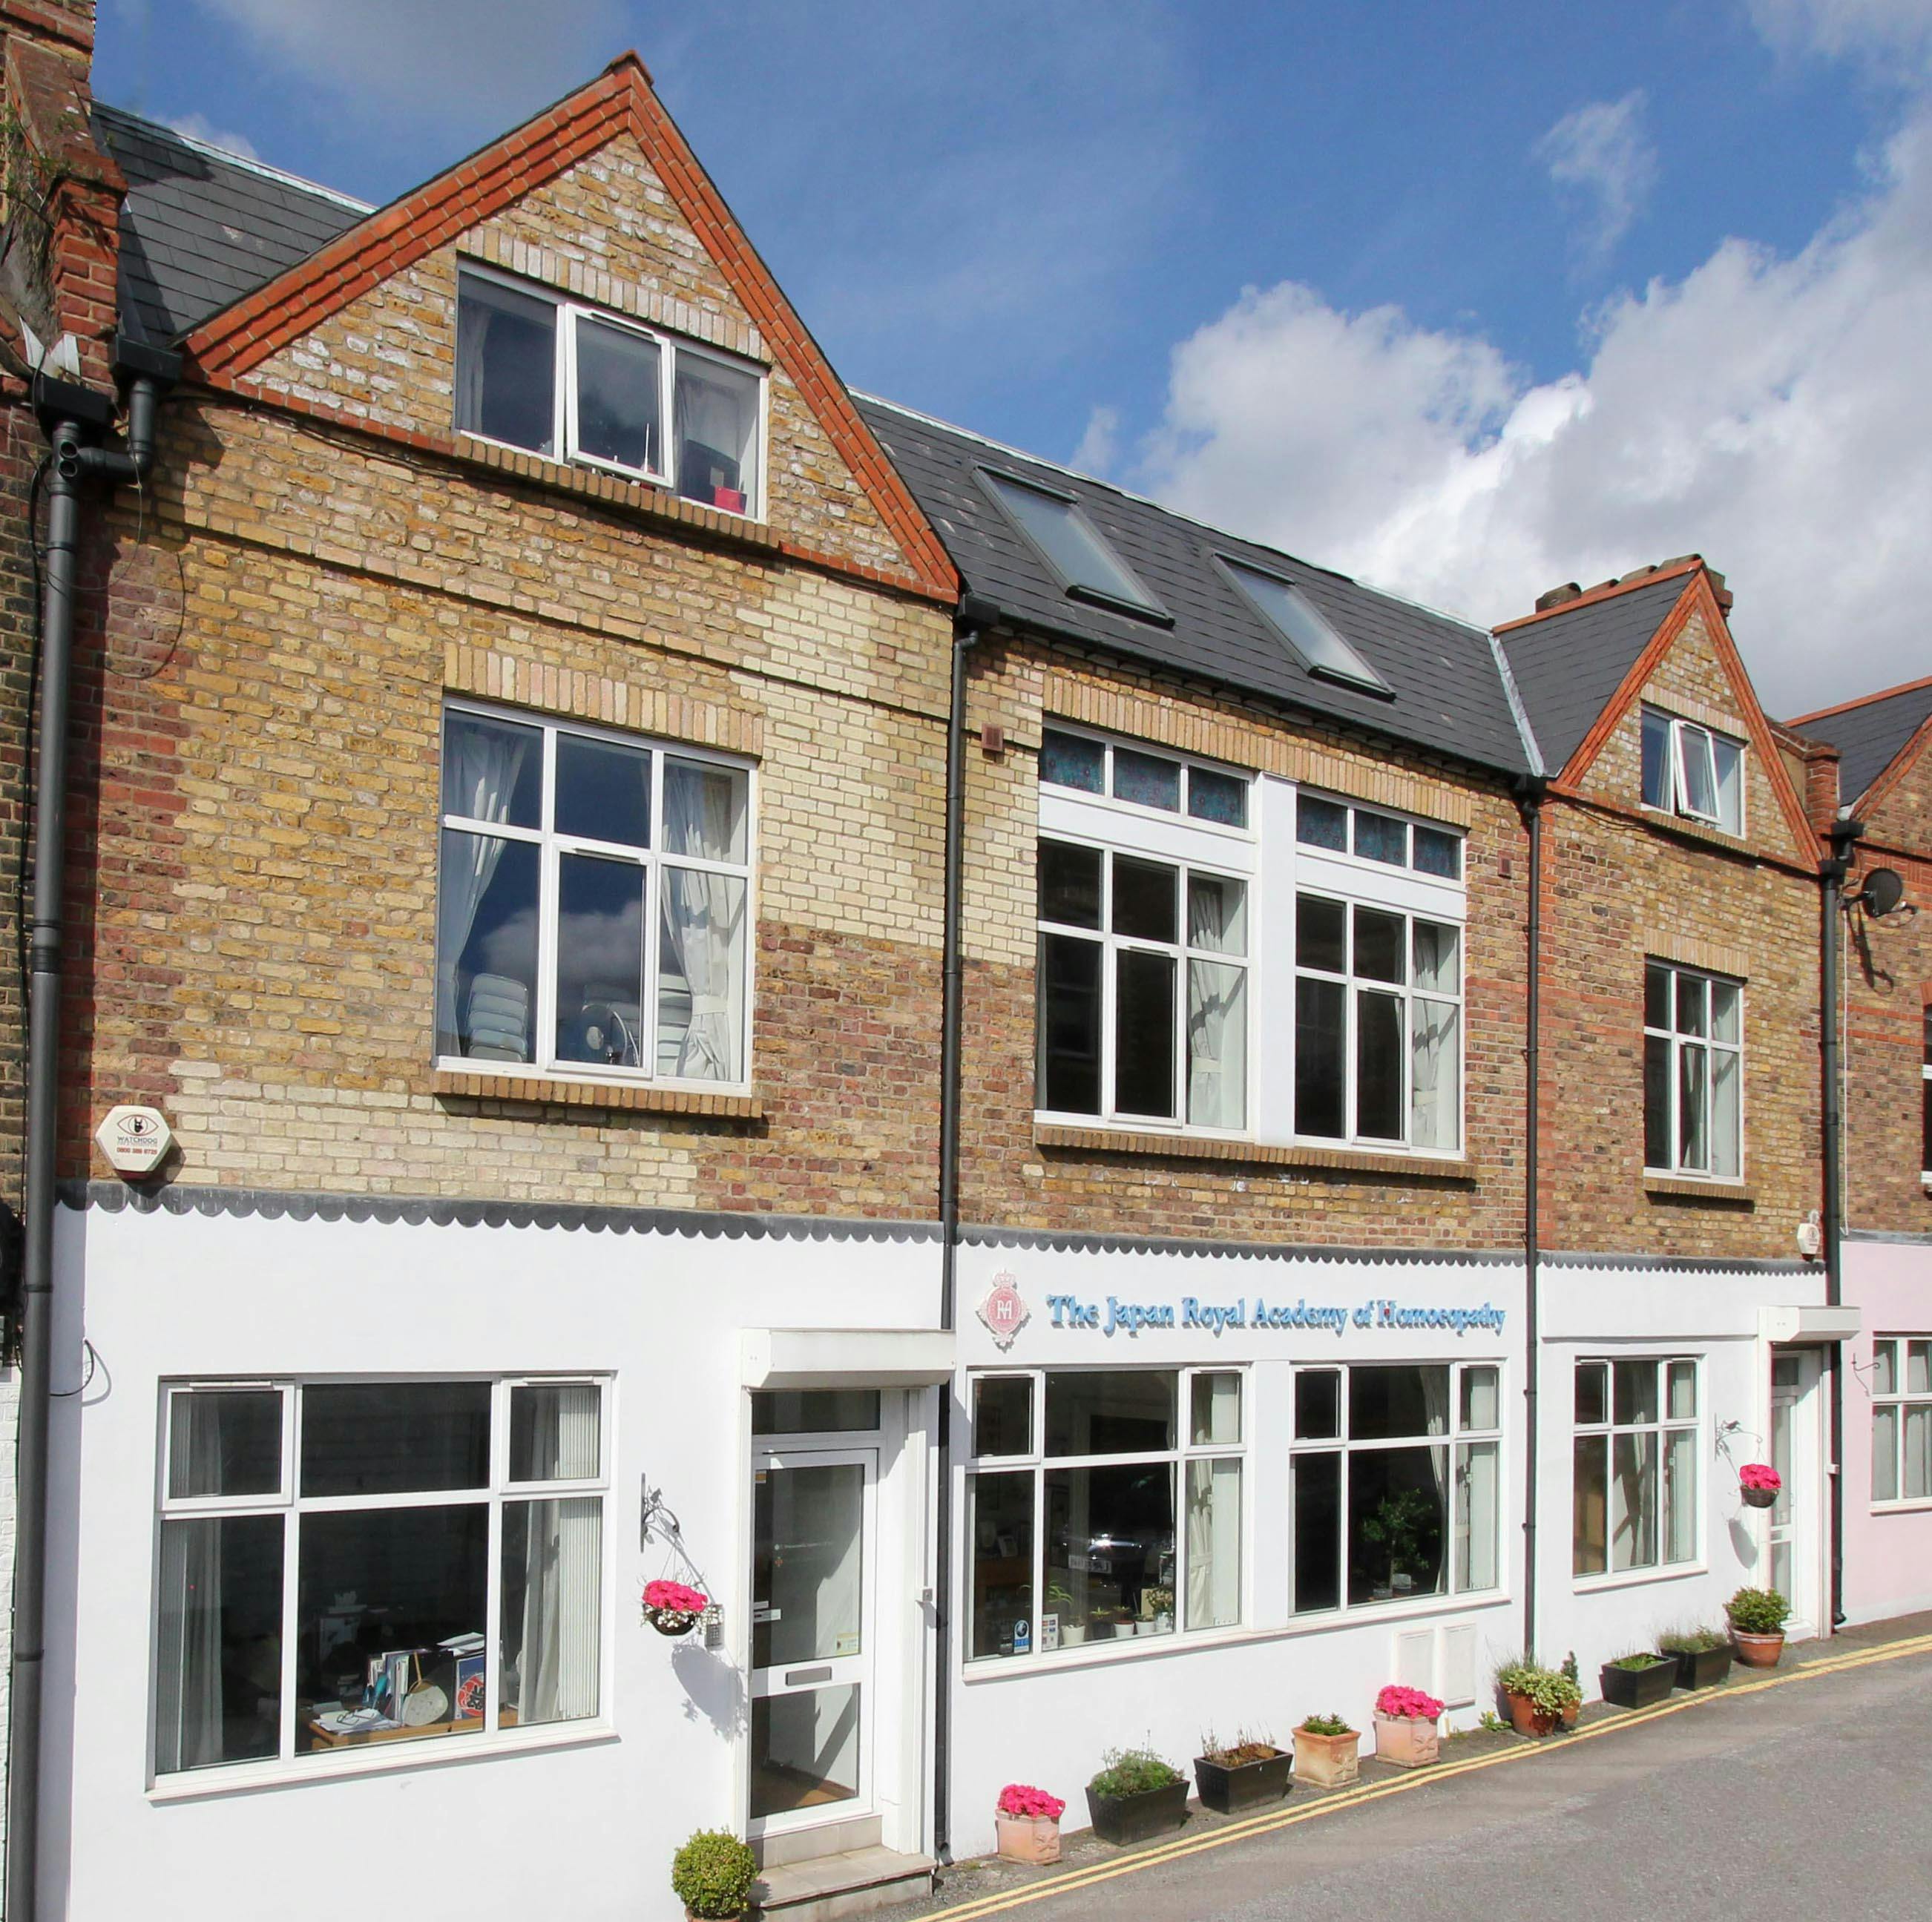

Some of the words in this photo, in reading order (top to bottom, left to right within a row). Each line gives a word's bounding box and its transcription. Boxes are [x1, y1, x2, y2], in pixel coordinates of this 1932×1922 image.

[117, 1136, 158, 1144] WATCHDOG
[1047, 1294, 1100, 1328] The
[1103, 1295, 1176, 1337] Japan
[1182, 1296, 1246, 1337] Royal
[1251, 1297, 1348, 1337] Academy
[1352, 1299, 1374, 1329] of
[1376, 1300, 1507, 1337] Homoeopathy
